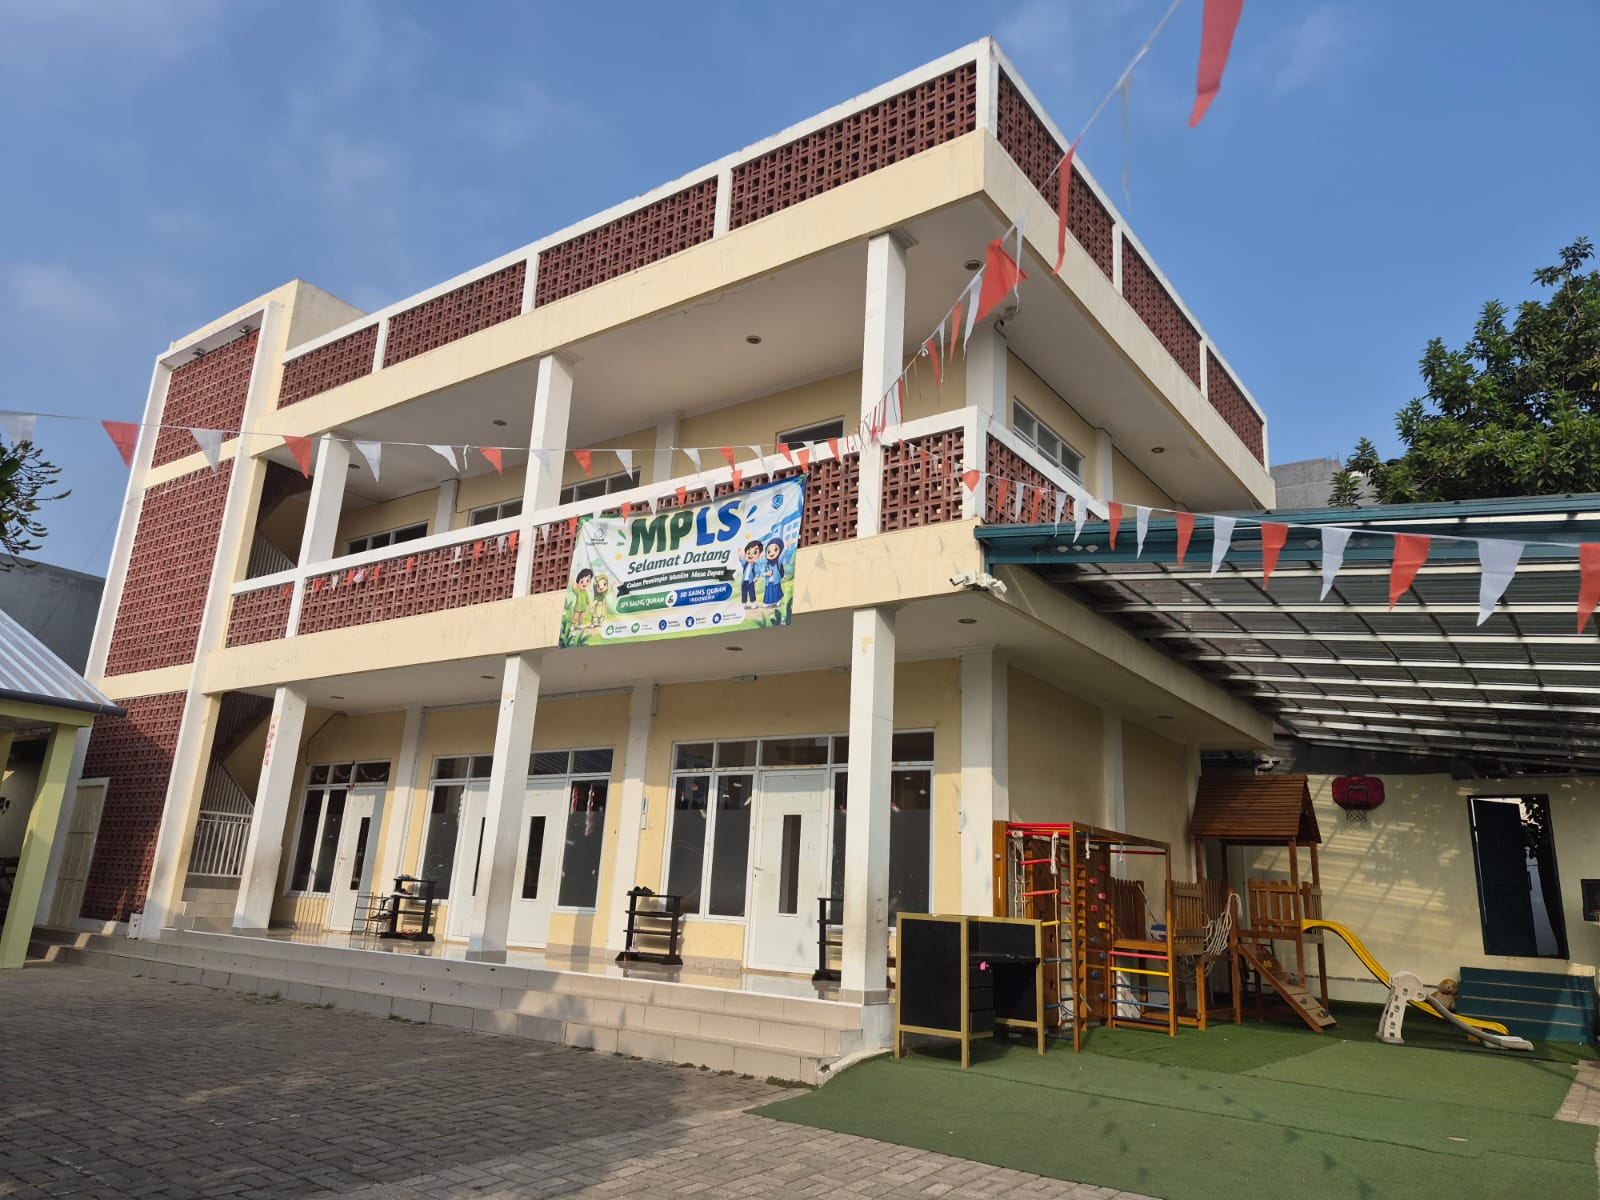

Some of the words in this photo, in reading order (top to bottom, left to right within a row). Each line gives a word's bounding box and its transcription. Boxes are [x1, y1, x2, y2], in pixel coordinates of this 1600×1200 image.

[628, 500, 742, 556] MPLS
[627, 554, 681, 575] Selamat
[683, 549, 731, 564] Datang
[642, 576, 668, 586] Pemimpin
[668, 572, 689, 581] Muslim
[707, 569, 725, 577] Depan
[646, 596, 665, 606] QURAN
[667, 595, 674, 603] &
[706, 586, 727, 596] QURAN
